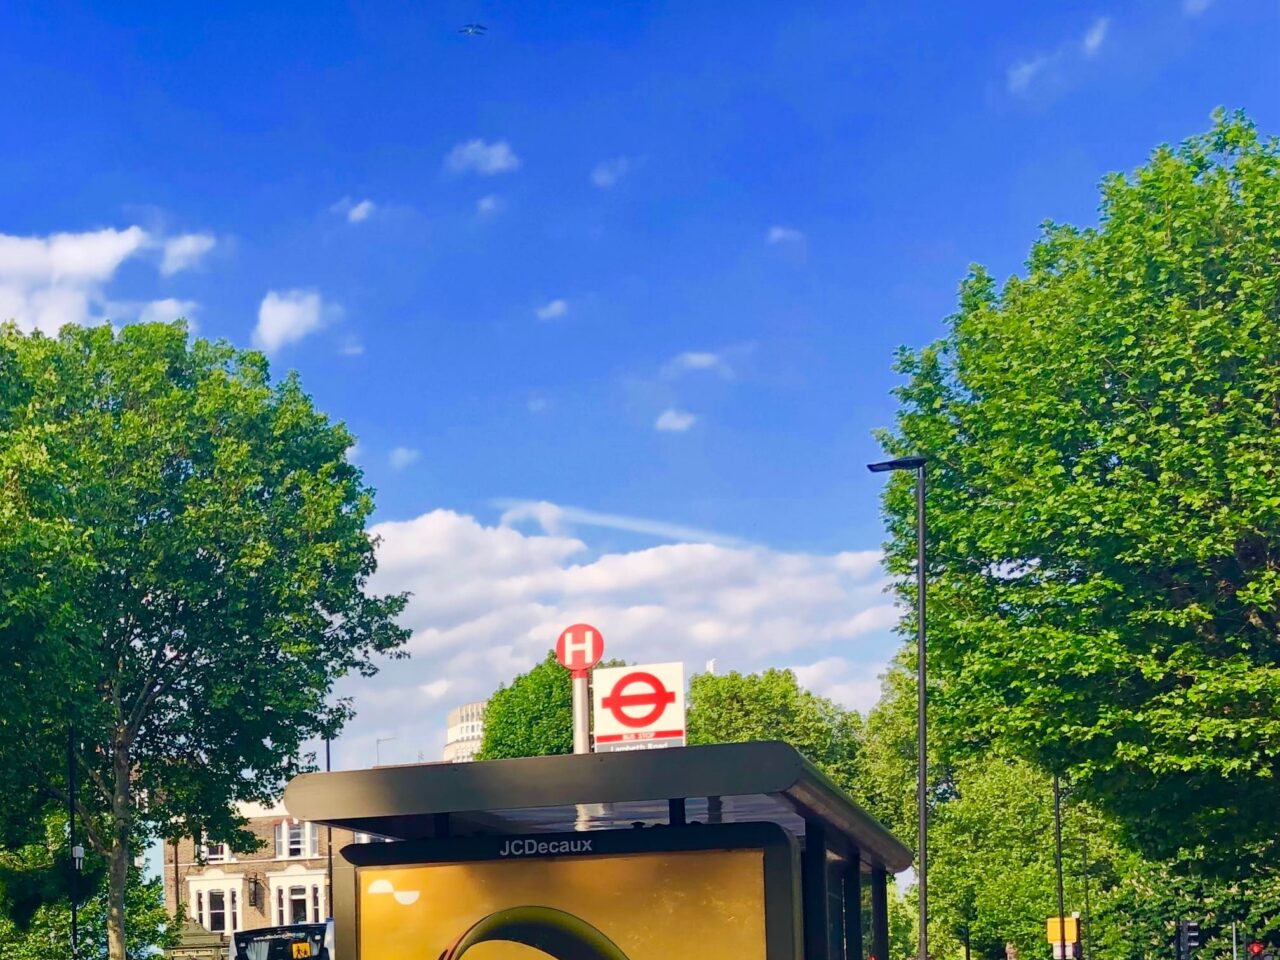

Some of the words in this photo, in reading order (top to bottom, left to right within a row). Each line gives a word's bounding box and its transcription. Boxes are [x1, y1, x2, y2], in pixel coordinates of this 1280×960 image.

[564, 631, 594, 666] H
[638, 731, 656, 740] STOP
[647, 742, 668, 750] Road
[500, 839, 593, 856] JCDecaux
